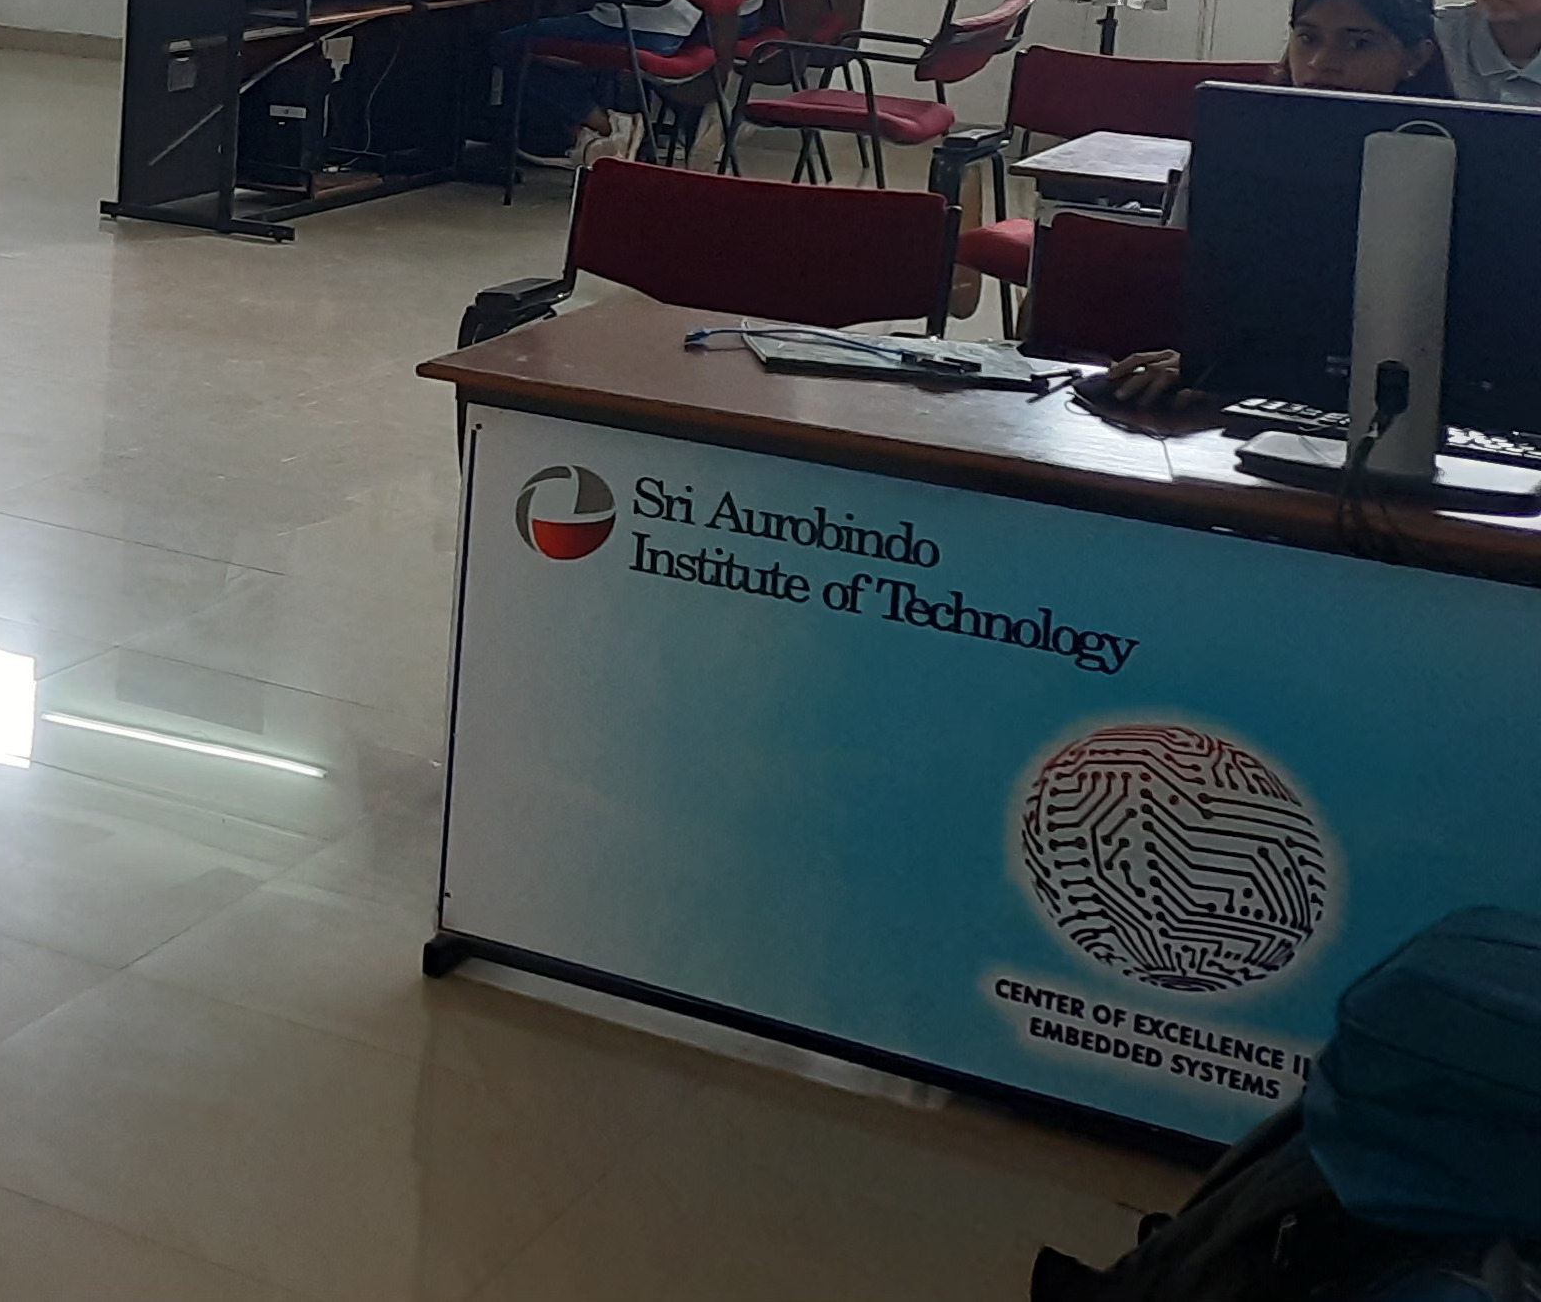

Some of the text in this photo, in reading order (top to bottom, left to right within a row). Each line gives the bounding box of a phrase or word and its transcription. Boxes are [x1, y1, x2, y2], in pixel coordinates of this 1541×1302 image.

[632, 475, 942, 570] Sri Aurobindo
[628, 530, 1141, 676] Institute of Technology
[993, 977, 1086, 1020] CENTER
[1091, 1003, 1127, 1029] OF
[1132, 1012, 1285, 1072] EXCELLENCE
[1028, 1016, 1282, 1100] EMBEDDED SYSTEMS
